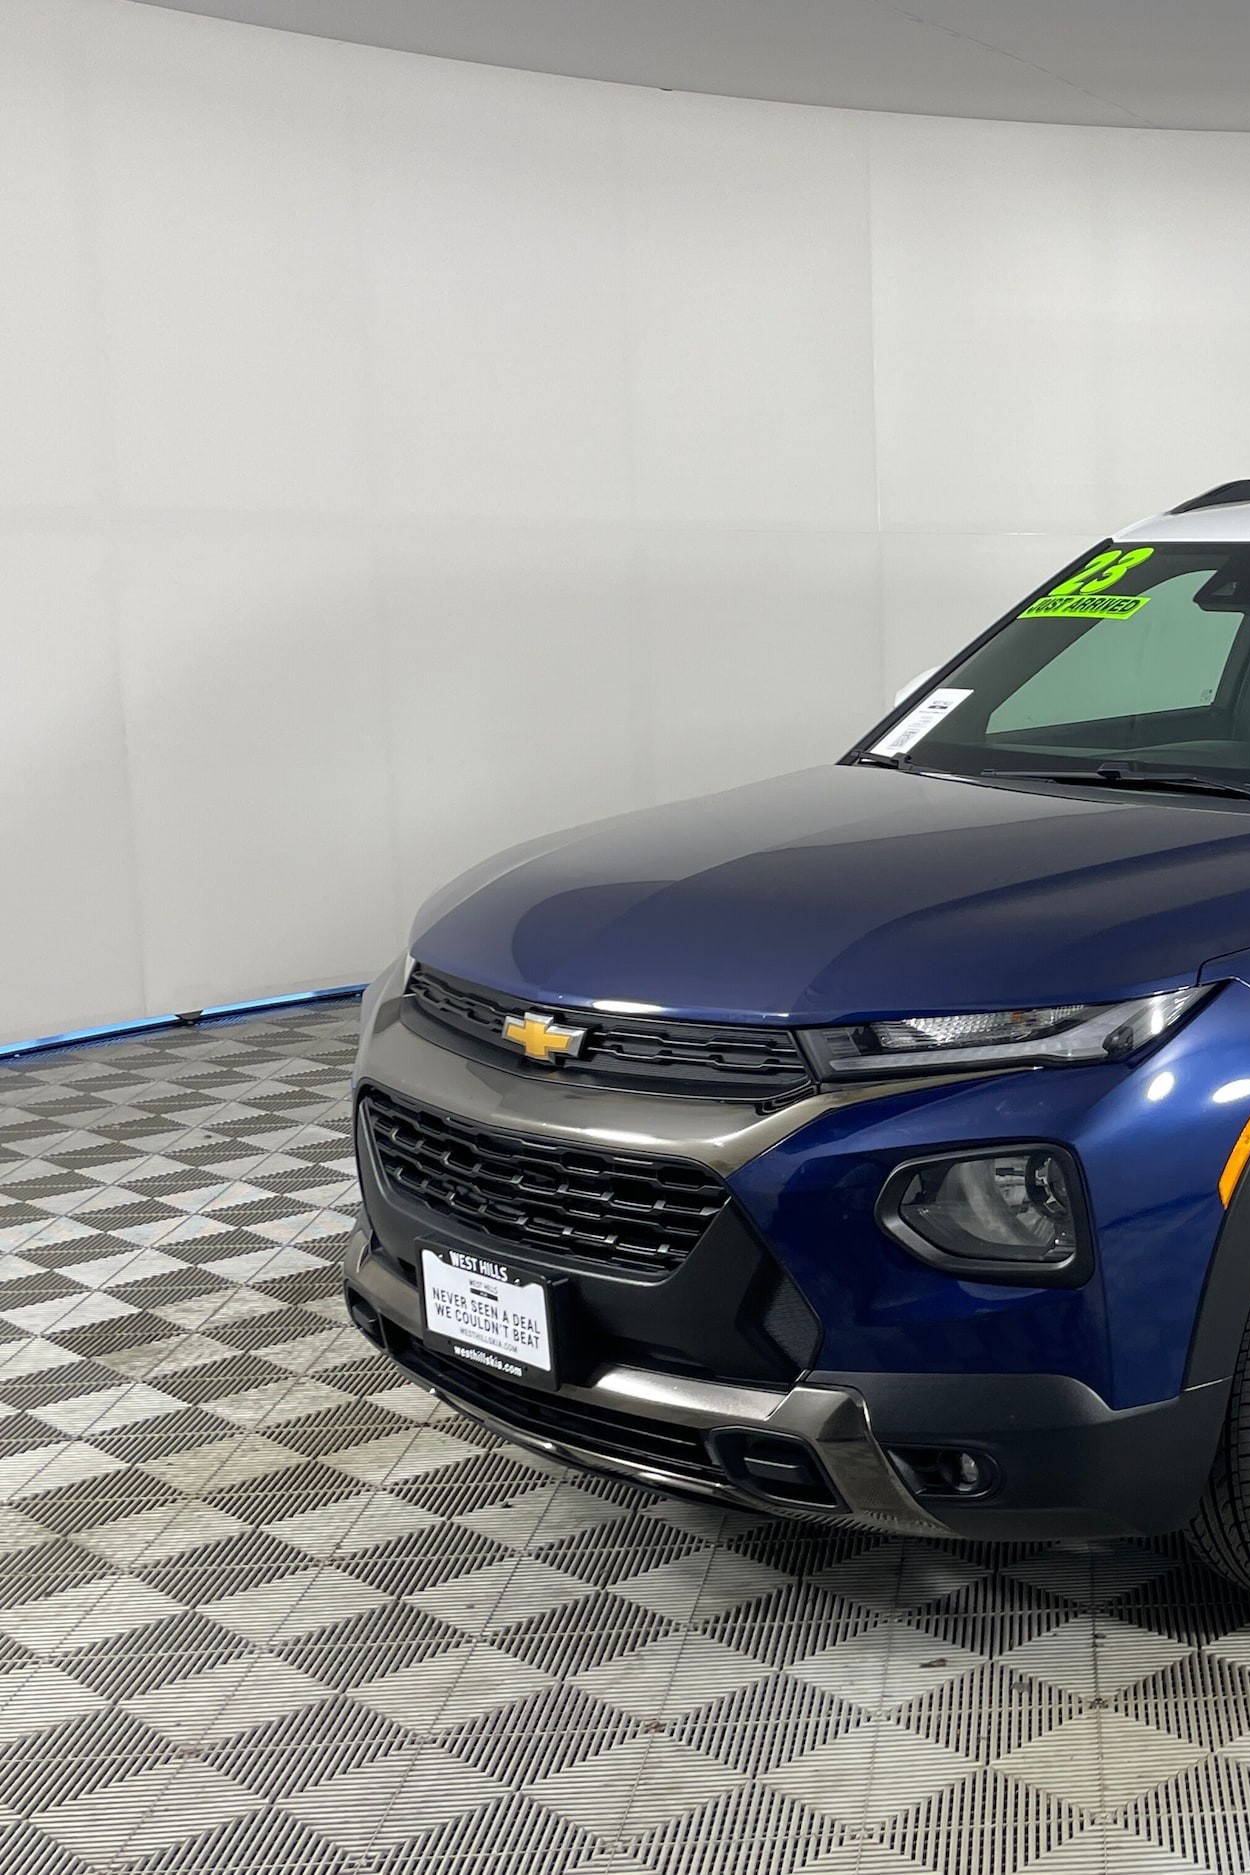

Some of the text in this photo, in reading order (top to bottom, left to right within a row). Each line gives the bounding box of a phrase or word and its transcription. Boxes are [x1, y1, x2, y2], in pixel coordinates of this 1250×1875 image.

[1048, 547, 1154, 595] 23
[1027, 597, 1140, 614] JUST ARRIVED
[449, 1251, 508, 1282] WEST HILLS
[432, 1287, 541, 1334] NEVER SEEN A DEAL
[435, 1303, 540, 1349] WE COULDN'T BEAT
[454, 1346, 522, 1377] westhillskia.com
